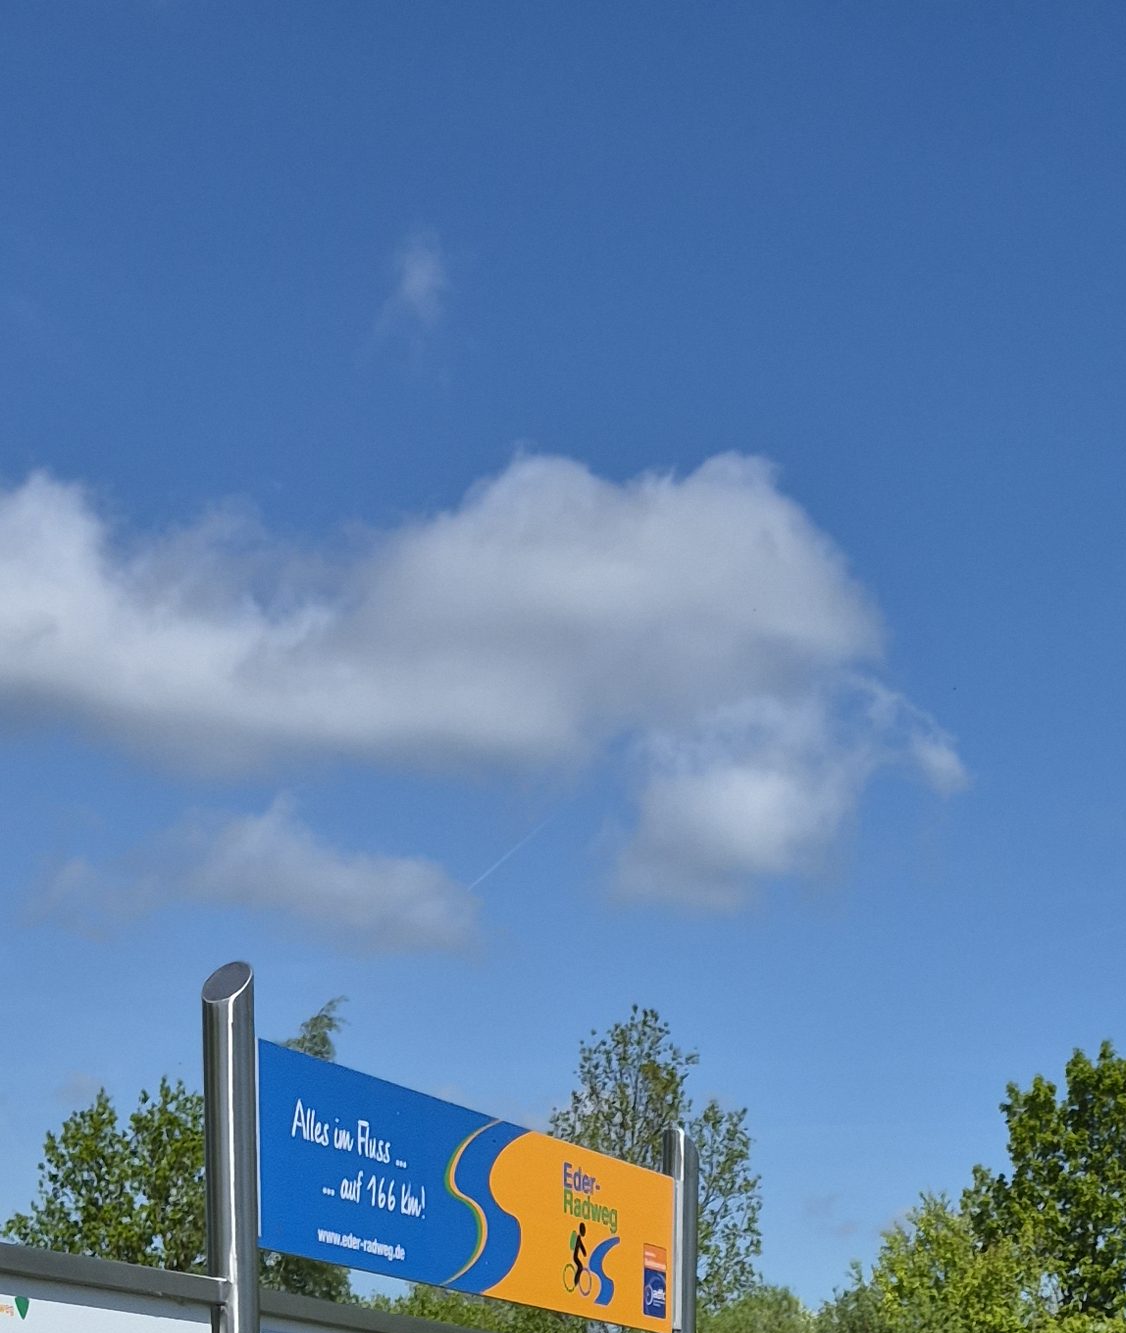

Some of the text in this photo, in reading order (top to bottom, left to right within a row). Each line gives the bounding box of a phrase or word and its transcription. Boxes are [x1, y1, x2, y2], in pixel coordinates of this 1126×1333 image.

[292, 1098, 330, 1146] Alles
[334, 1118, 354, 1152] im
[357, 1119, 391, 1164] Fluss
[340, 1170, 363, 1203] auf
[367, 1175, 396, 1212] 166
[563, 1162, 601, 1196] Eder-
[563, 1189, 618, 1234] Radweg
[317, 1228, 406, 1261] www.eder-radweg.de
